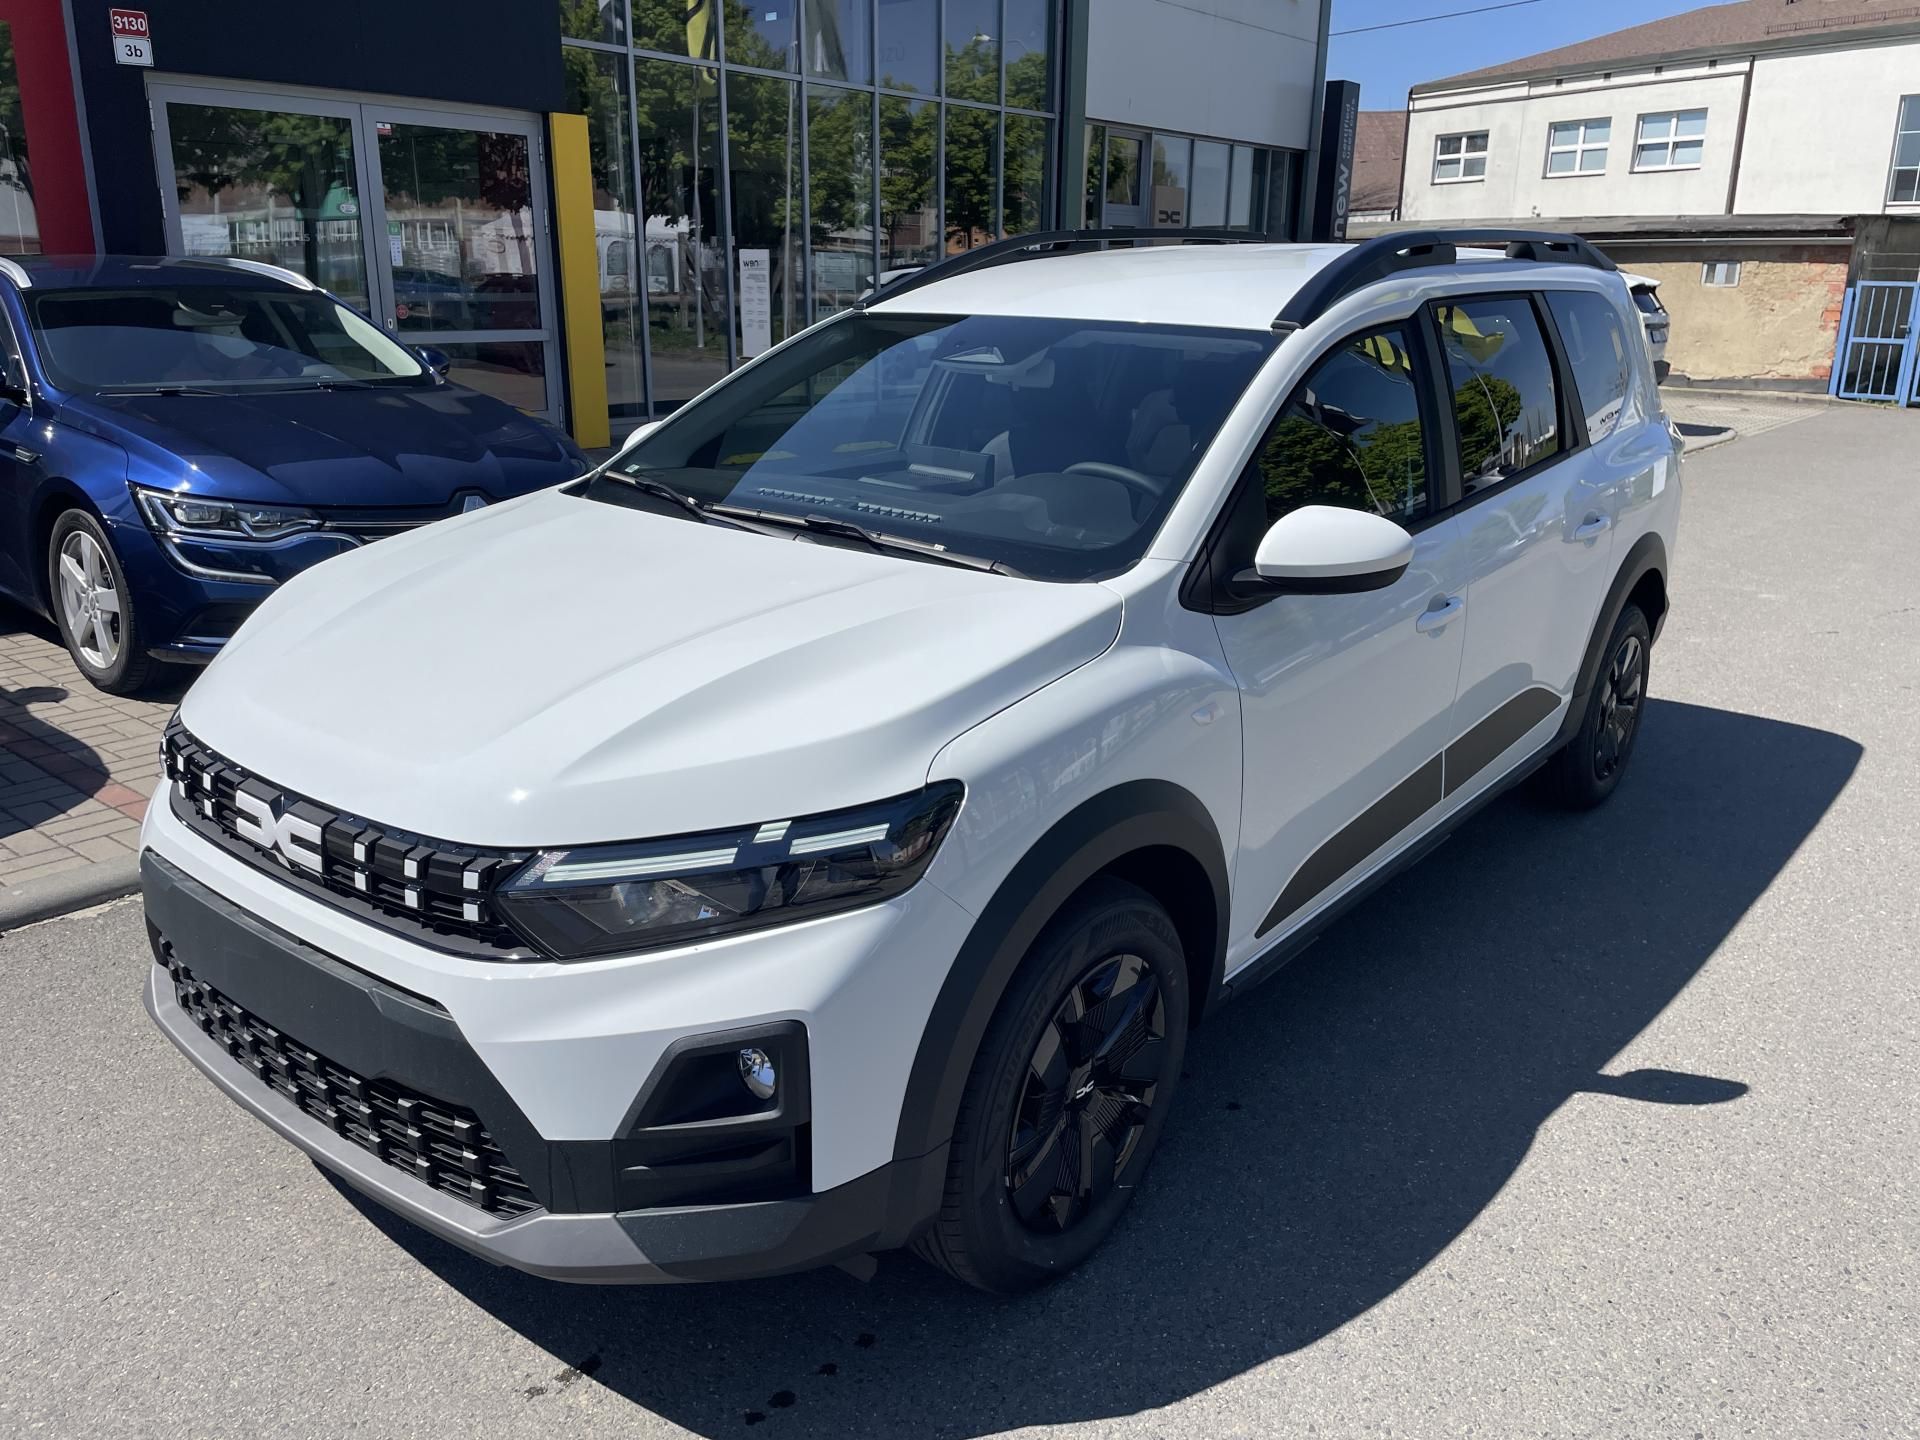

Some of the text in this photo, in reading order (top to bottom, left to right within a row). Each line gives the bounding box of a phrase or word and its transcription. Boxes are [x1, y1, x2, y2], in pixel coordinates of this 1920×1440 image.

[113, 15, 146, 31] 3130
[124, 44, 143, 58] 3b
[1333, 163, 1350, 242] new
